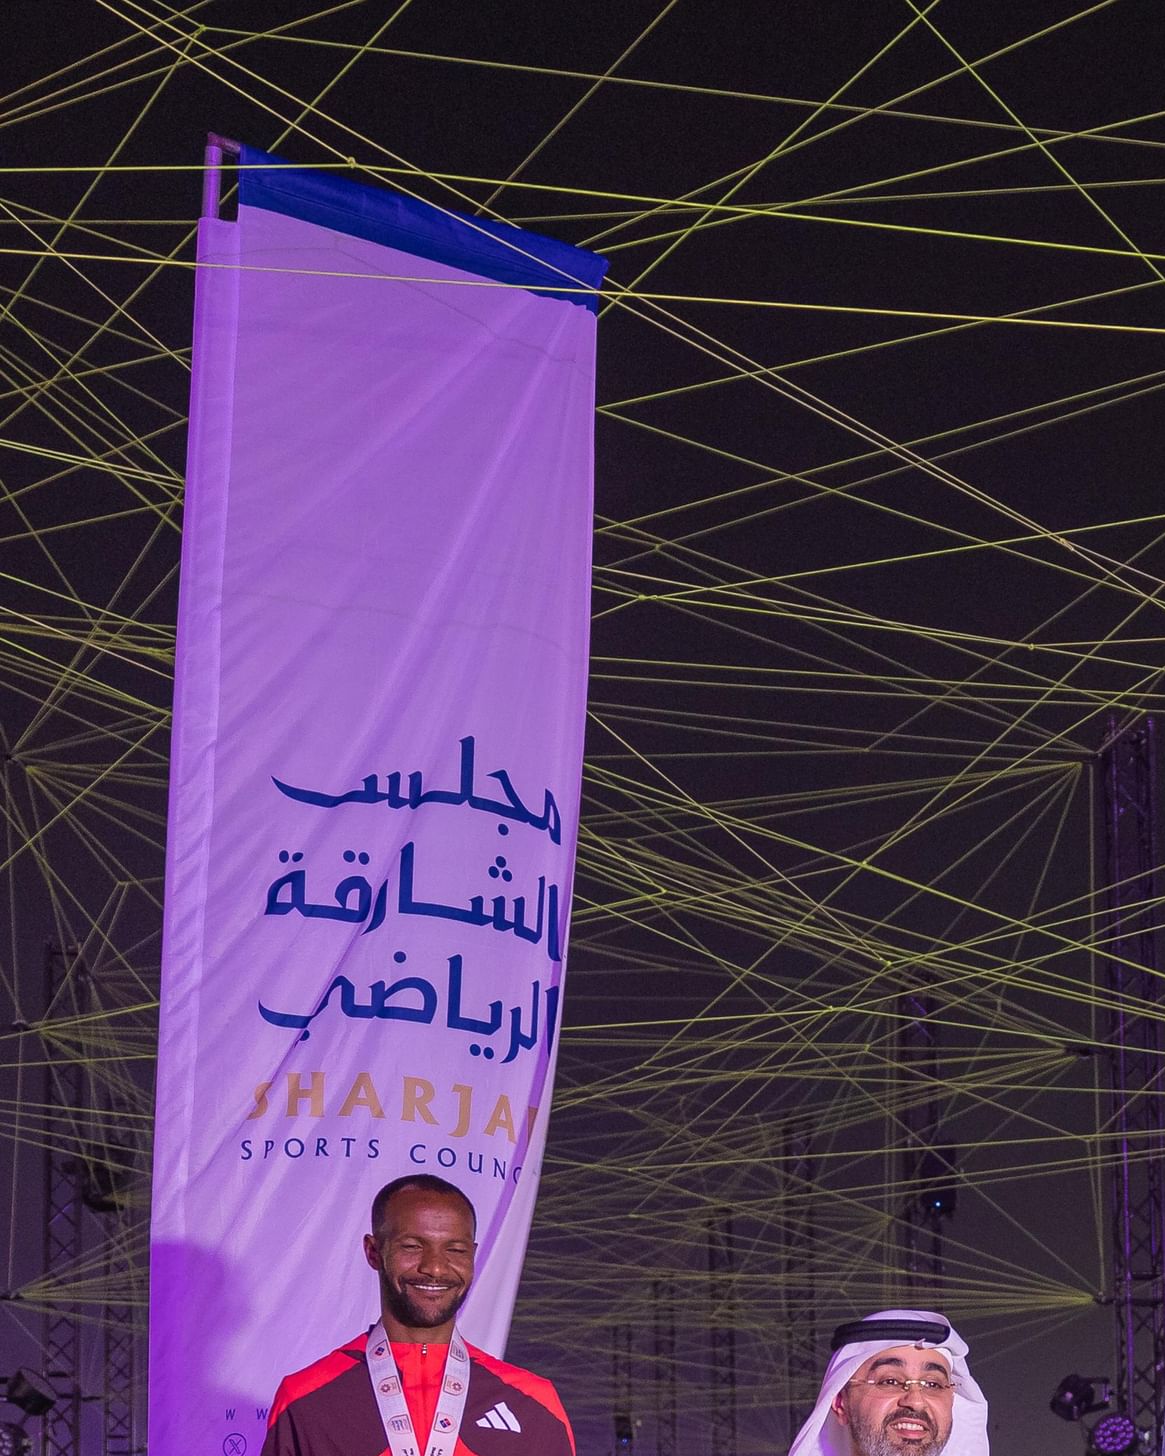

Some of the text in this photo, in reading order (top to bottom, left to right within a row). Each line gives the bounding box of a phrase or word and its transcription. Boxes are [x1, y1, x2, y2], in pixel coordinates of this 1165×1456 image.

[271, 736, 561, 845] مجلس
[264, 842, 561, 962] الشارقة
[258, 951, 559, 1064] الرياضي
[240, 1137, 522, 1185] SPORTS COUNC
